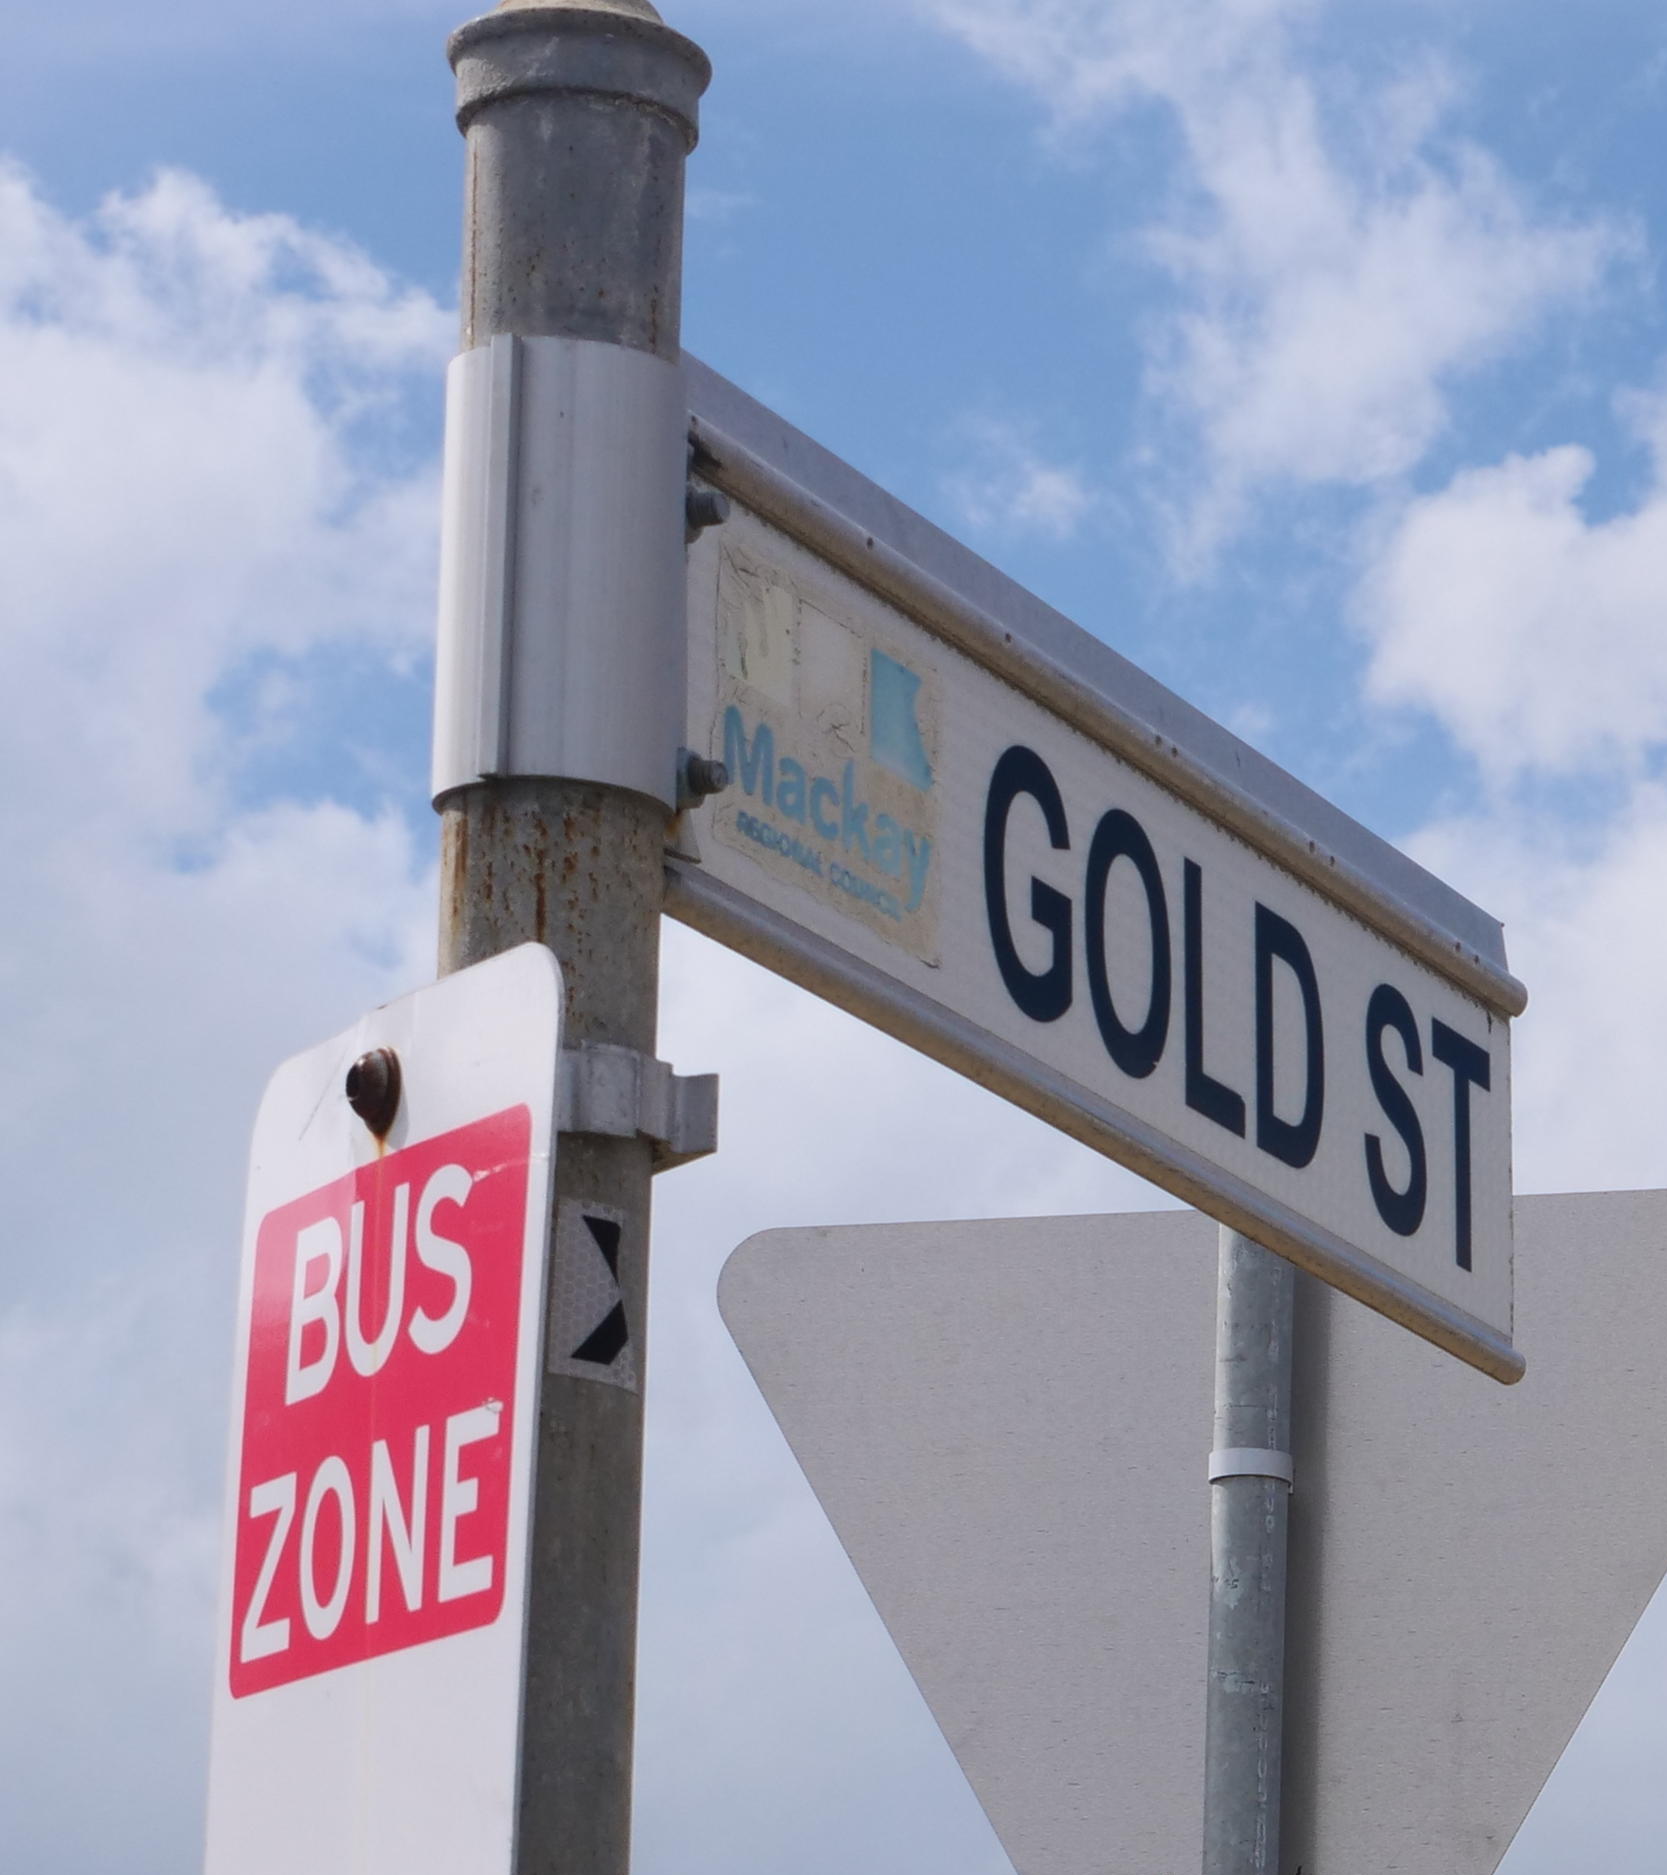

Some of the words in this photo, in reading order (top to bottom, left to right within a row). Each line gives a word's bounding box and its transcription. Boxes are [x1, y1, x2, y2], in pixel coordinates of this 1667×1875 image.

[724, 704, 933, 912] Mackay
[984, 744, 1325, 1169] GOLD
[1364, 983, 1491, 1273] ST
[285, 1163, 473, 1405] BUS
[240, 1401, 501, 1664] ZONE
